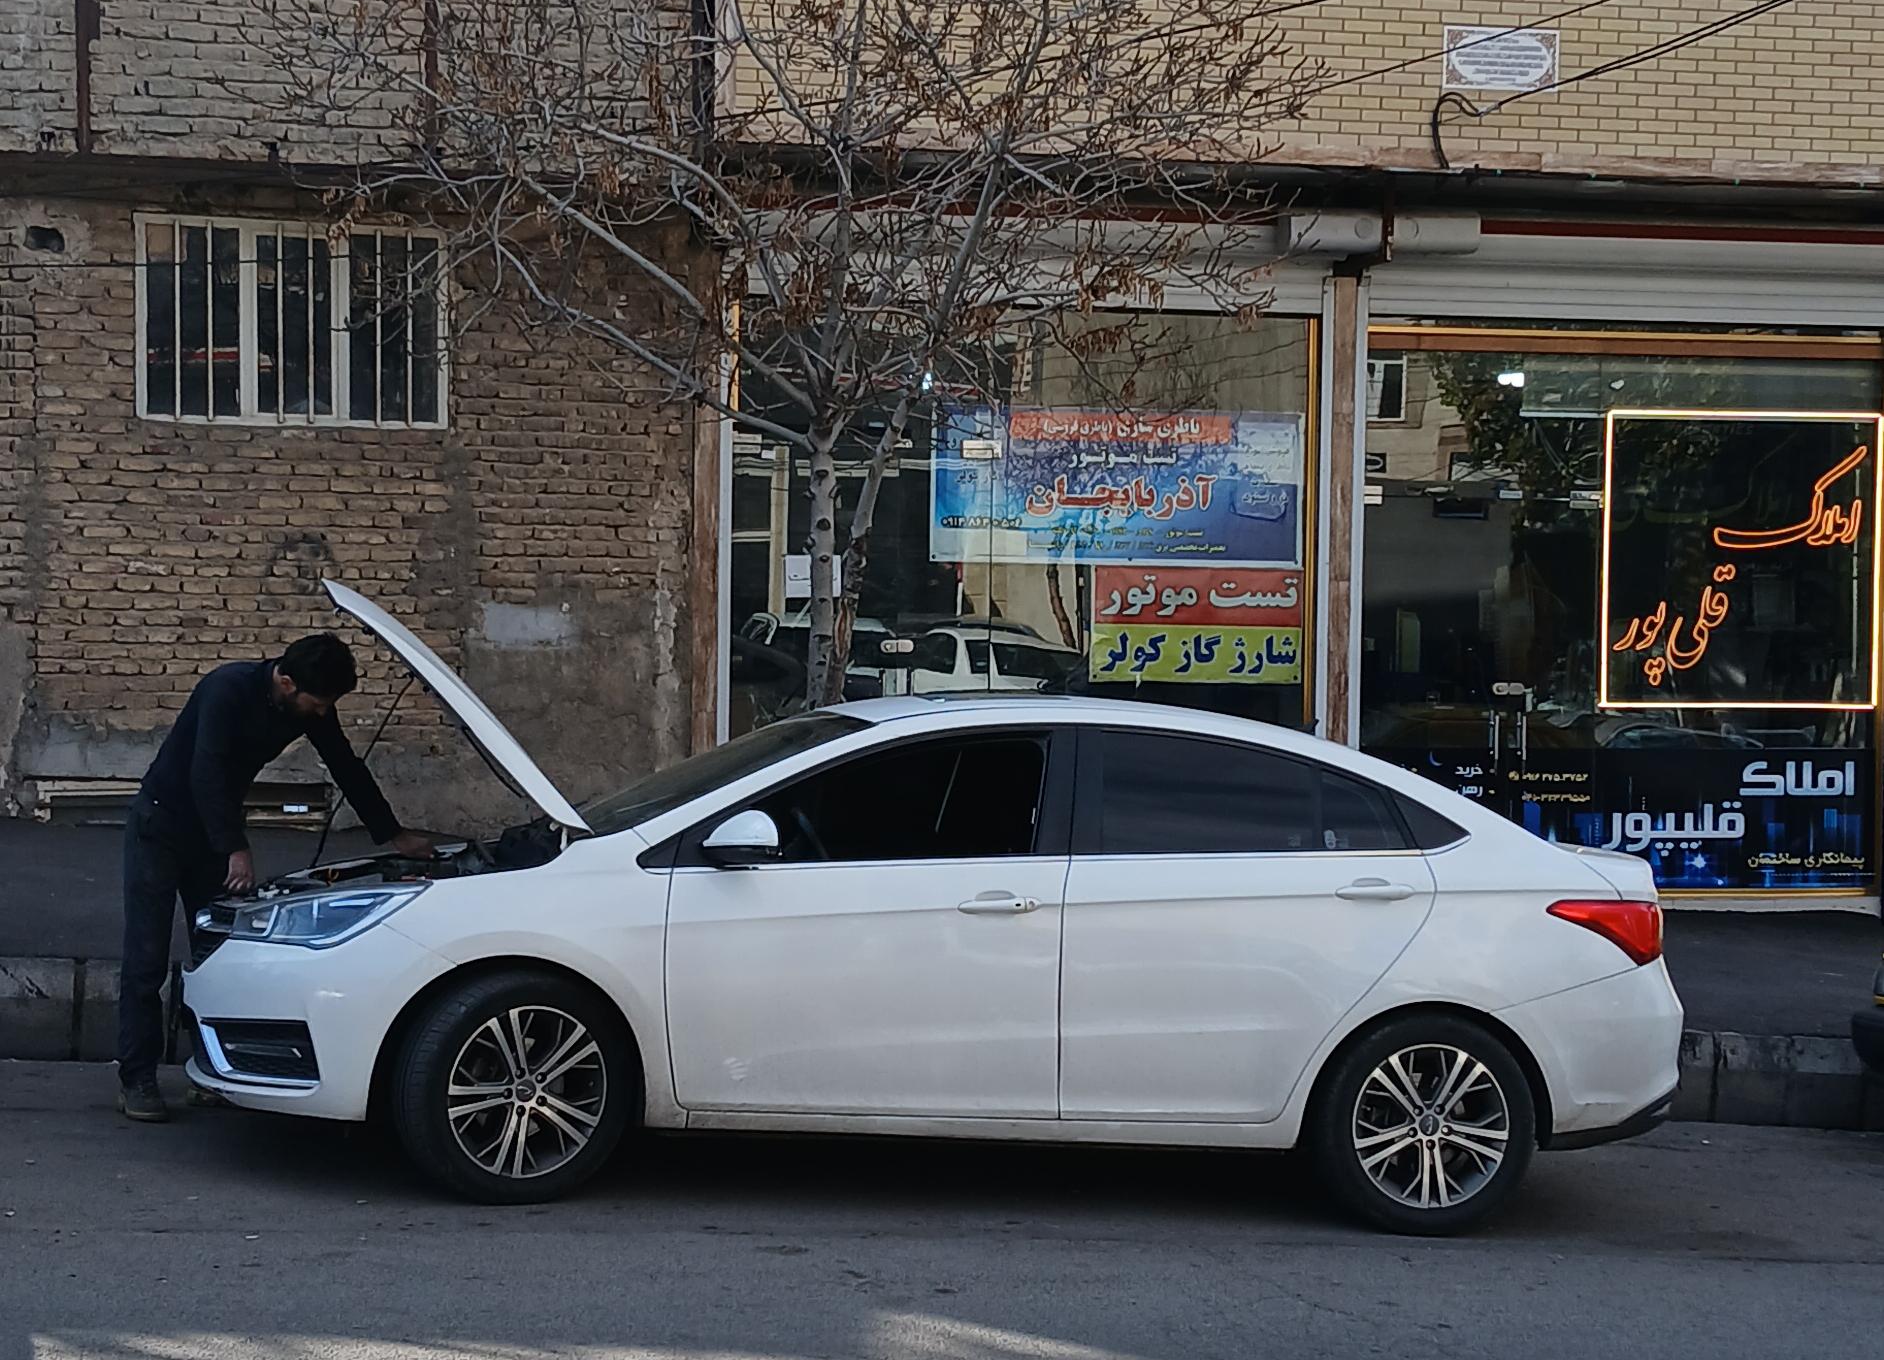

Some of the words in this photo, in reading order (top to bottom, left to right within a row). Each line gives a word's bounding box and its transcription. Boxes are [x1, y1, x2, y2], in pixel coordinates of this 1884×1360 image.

[1157, 417, 1200, 438] باطری
[1068, 446, 1138, 469] موتور
[1142, 447, 1178, 464] تست
[1025, 474, 1218, 519] آذربایجان
[1713, 444, 1868, 550] املاک
[1100, 574, 1198, 616] موتور
[1209, 577, 1299, 609] تست
[1666, 563, 1737, 670] قلی
[1100, 632, 1167, 673] کولر
[1174, 634, 1222, 673] گاز
[1229, 635, 1297, 675] شارژ
[1611, 600, 1667, 687] پور
[1454, 763, 1484, 778] خرید
[1739, 761, 1856, 796] املاک
[1601, 801, 1746, 857] قلیپور
[1804, 853, 1866, 870] پیمانکاری
